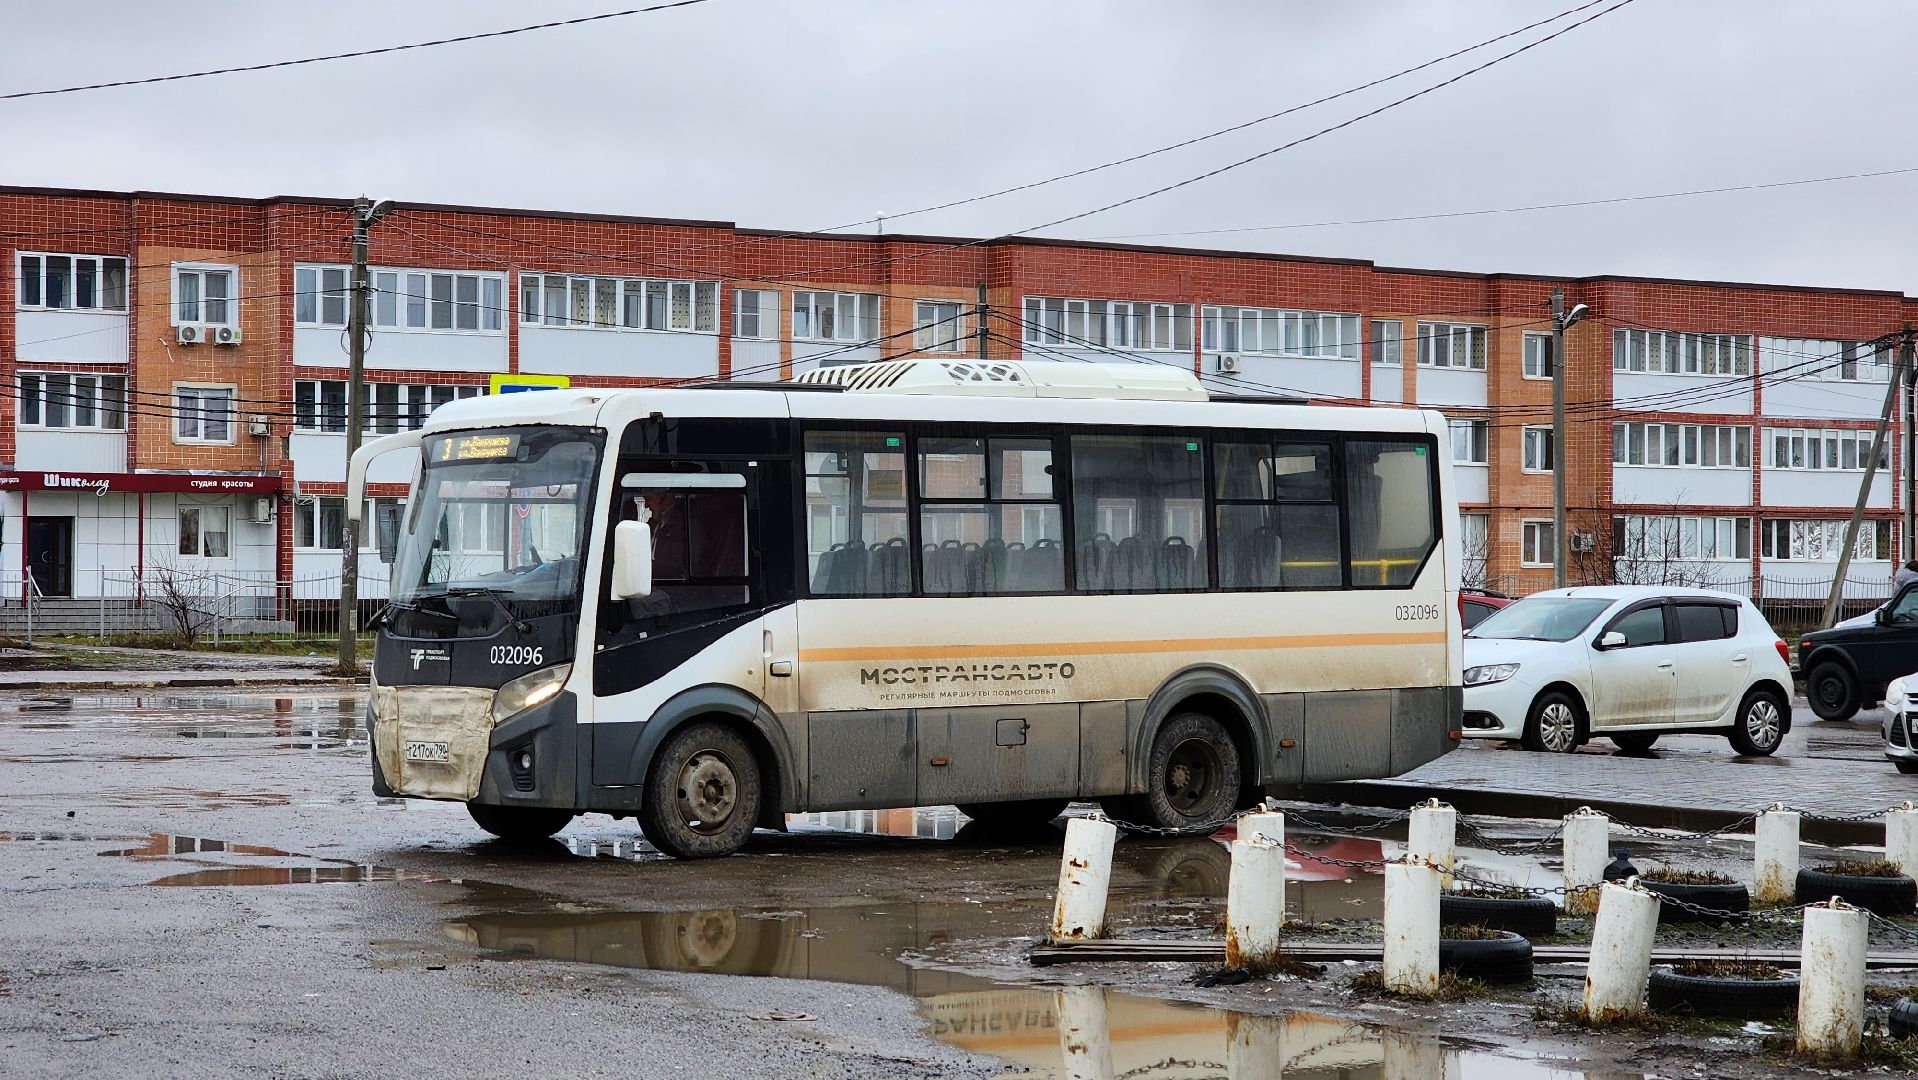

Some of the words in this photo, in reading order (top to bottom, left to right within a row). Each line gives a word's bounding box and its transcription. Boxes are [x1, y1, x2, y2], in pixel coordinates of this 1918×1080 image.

[442, 438, 453, 461] 3
[43, 473, 110, 497] Шиколад
[190, 480, 218, 489] студия
[221, 480, 254, 489] красоты
[1395, 604, 1439, 621] 032096
[490, 645, 543, 666] 032096
[860, 662, 1076, 685] МОСТРАНСАВТО
[880, 692, 936, 701] РЕГУЛЯРНЫЕ
[939, 690, 991, 699] МАРШРУТЫ
[993, 688, 1057, 697] ПОДМОСКОВЬЯ
